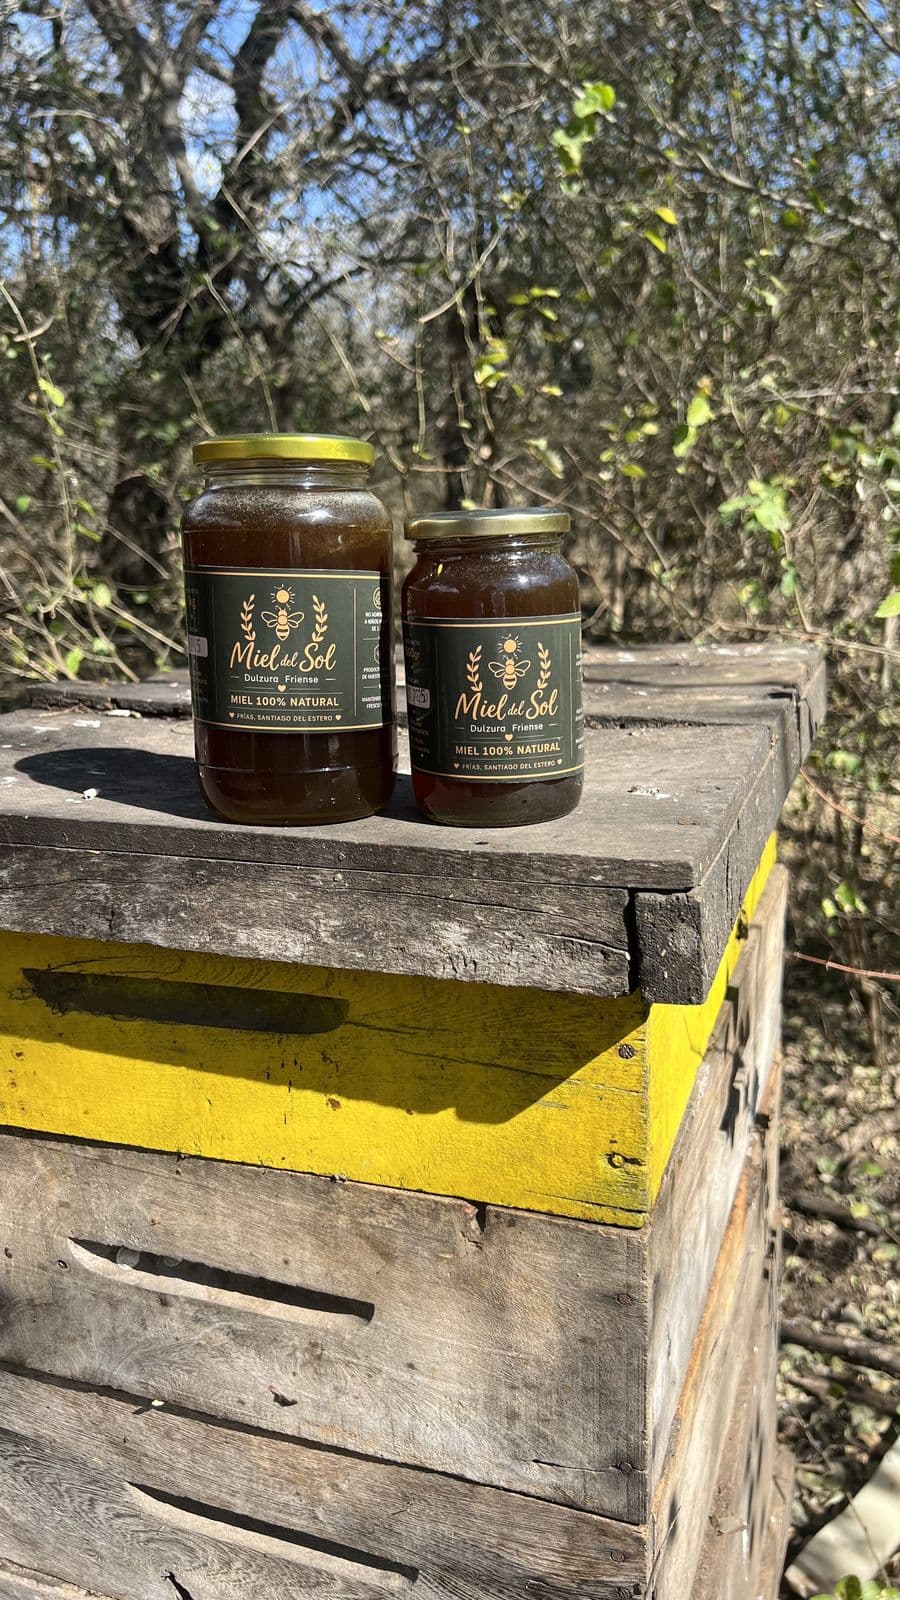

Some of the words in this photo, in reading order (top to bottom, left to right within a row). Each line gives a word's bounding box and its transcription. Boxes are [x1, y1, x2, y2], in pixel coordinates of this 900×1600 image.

[229, 641, 280, 671] Miel
[280, 651, 298, 667] del
[300, 642, 336, 672] Sol
[244, 674, 279, 684] Dulzura
[285, 675, 319, 684] Friense
[230, 694, 253, 705] MIEL
[256, 696, 286, 707] 100%
[290, 697, 339, 707] NATURAL
[455, 692, 508, 721] Miel
[507, 701, 525, 716] del
[526, 689, 558, 720] Sol
[257, 714, 291, 722] SANTIAGO
[470, 724, 506, 733] Dulzura
[512, 723, 544, 732] Friense
[455, 745, 479, 756] MIEL
[482, 745, 513, 756] 100%
[517, 742, 560, 755] NATURAL
[484, 763, 518, 771] SANTIAGO
[533, 759, 555, 769] ESTERO
